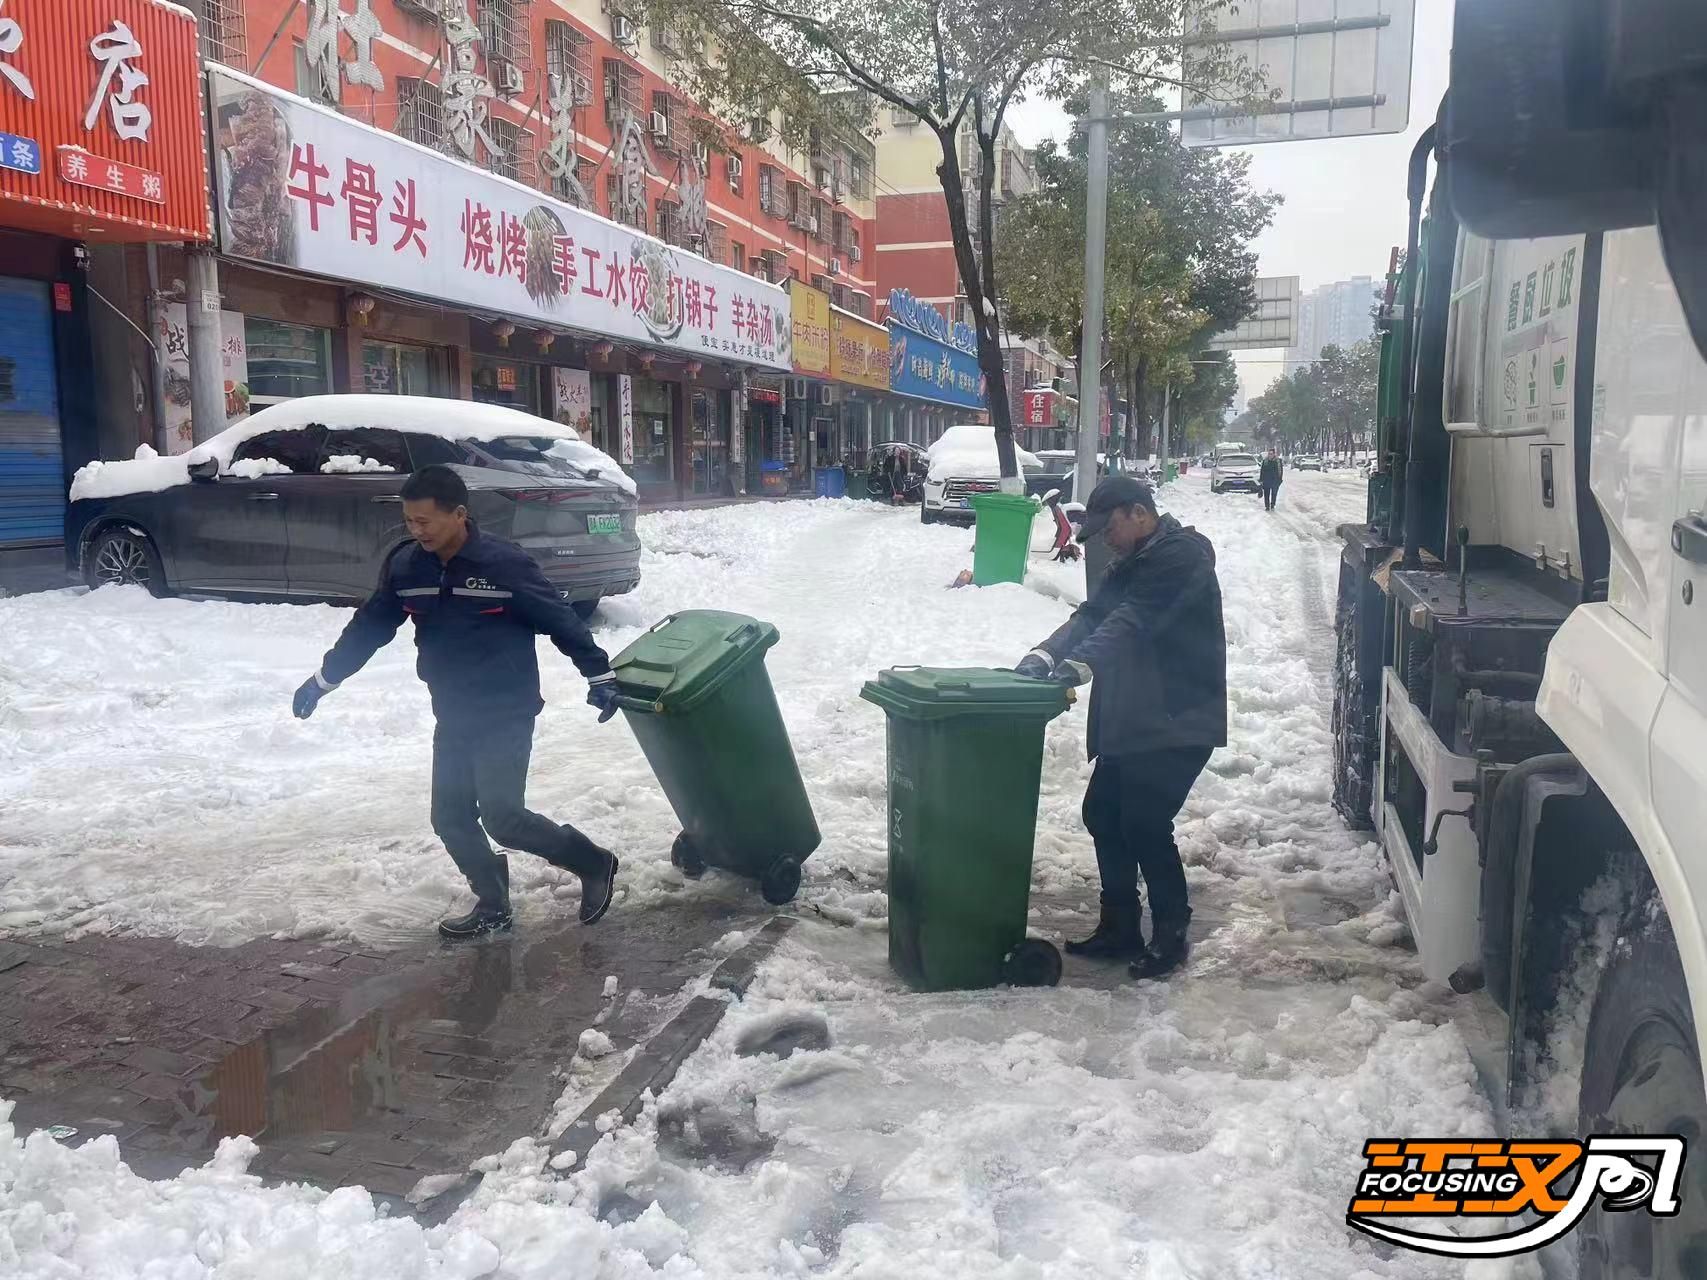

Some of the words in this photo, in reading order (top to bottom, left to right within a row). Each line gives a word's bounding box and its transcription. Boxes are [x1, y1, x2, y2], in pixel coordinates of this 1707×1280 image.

[67, 153, 161, 199] 养生粥
[287, 142, 427, 258] 牛骨头
[461, 198, 528, 284] 烧烤
[552, 235, 650, 314] 手工水饺
[666, 271, 718, 330] 打锅子
[732, 292, 772, 346] 羊杂汤
[1507, 246, 1577, 332] 餐厨垃圾
[1031, 393, 1044, 423] 住宿
